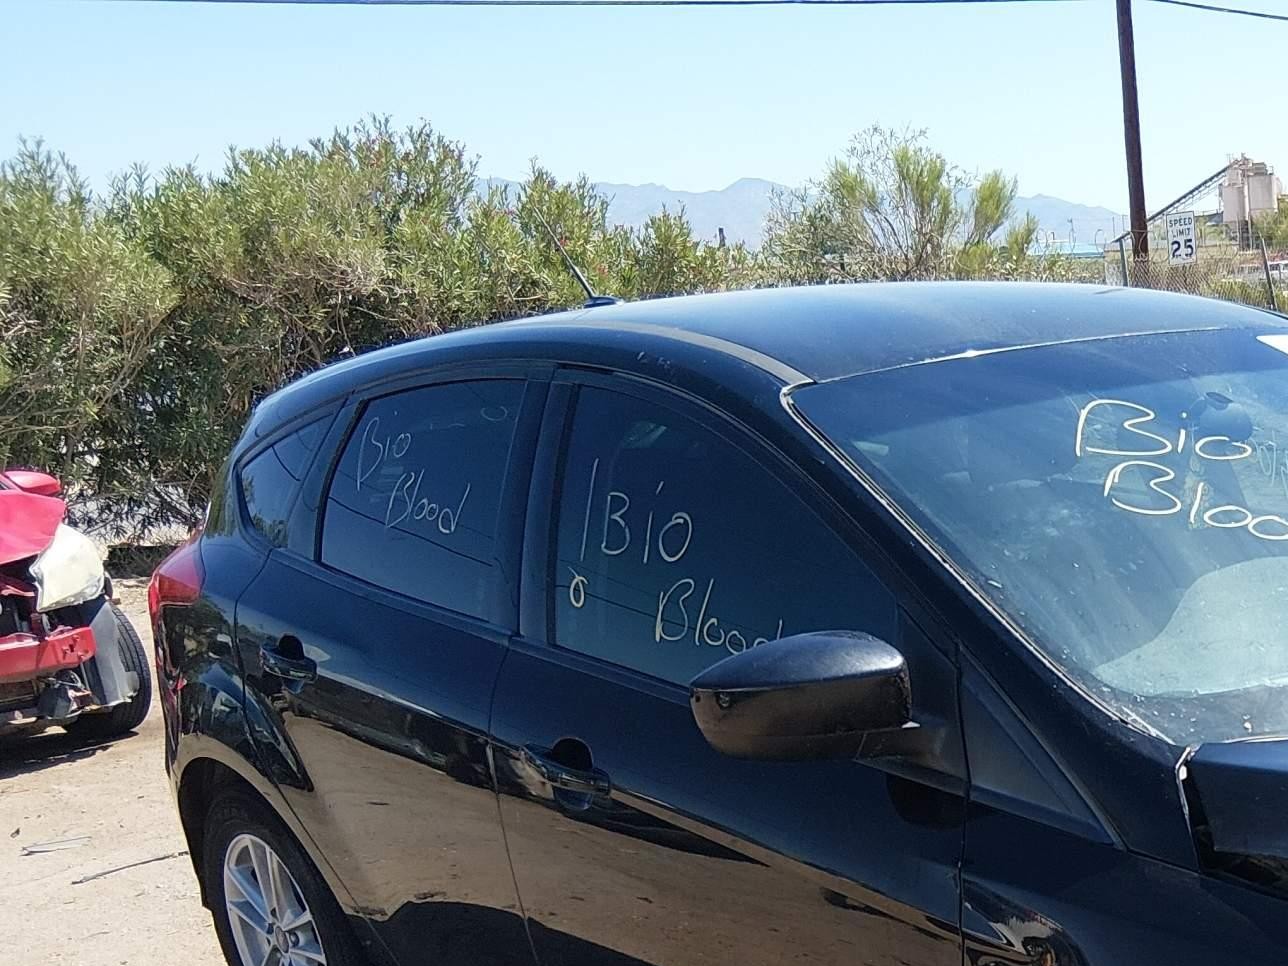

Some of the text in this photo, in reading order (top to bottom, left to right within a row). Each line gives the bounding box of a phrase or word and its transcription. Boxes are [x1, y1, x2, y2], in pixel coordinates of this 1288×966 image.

[1169, 217, 1192, 228] SPEED
[1171, 228, 1191, 238] LIMIT
[1171, 239, 1194, 258] 25
[1075, 399, 1252, 460] Bio
[356, 410, 412, 492] Bio
[385, 468, 471, 534] Blood
